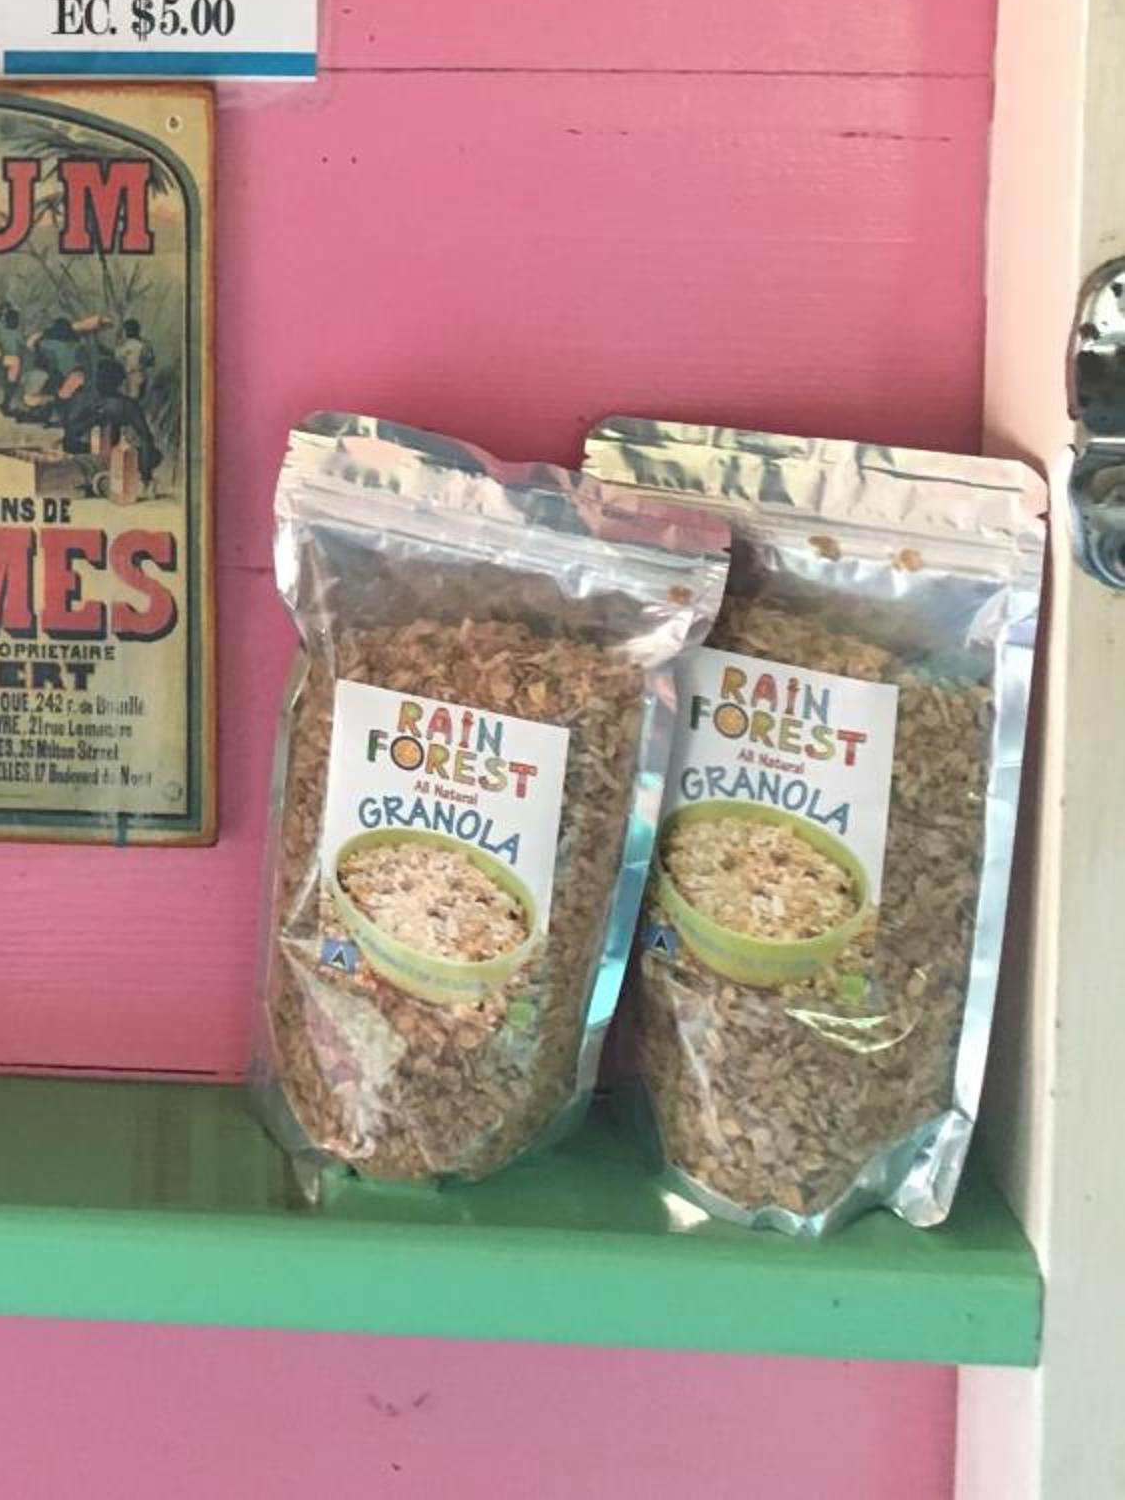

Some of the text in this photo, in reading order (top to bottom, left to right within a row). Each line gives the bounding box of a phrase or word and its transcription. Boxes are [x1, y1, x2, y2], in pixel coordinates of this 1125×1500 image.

[42, 496, 72, 524] DE
[367, 729, 538, 799] FOREST
[690, 695, 868, 767] FOREST
[358, 796, 522, 865] GRANOLA
[680, 766, 851, 836] GRANOLA
